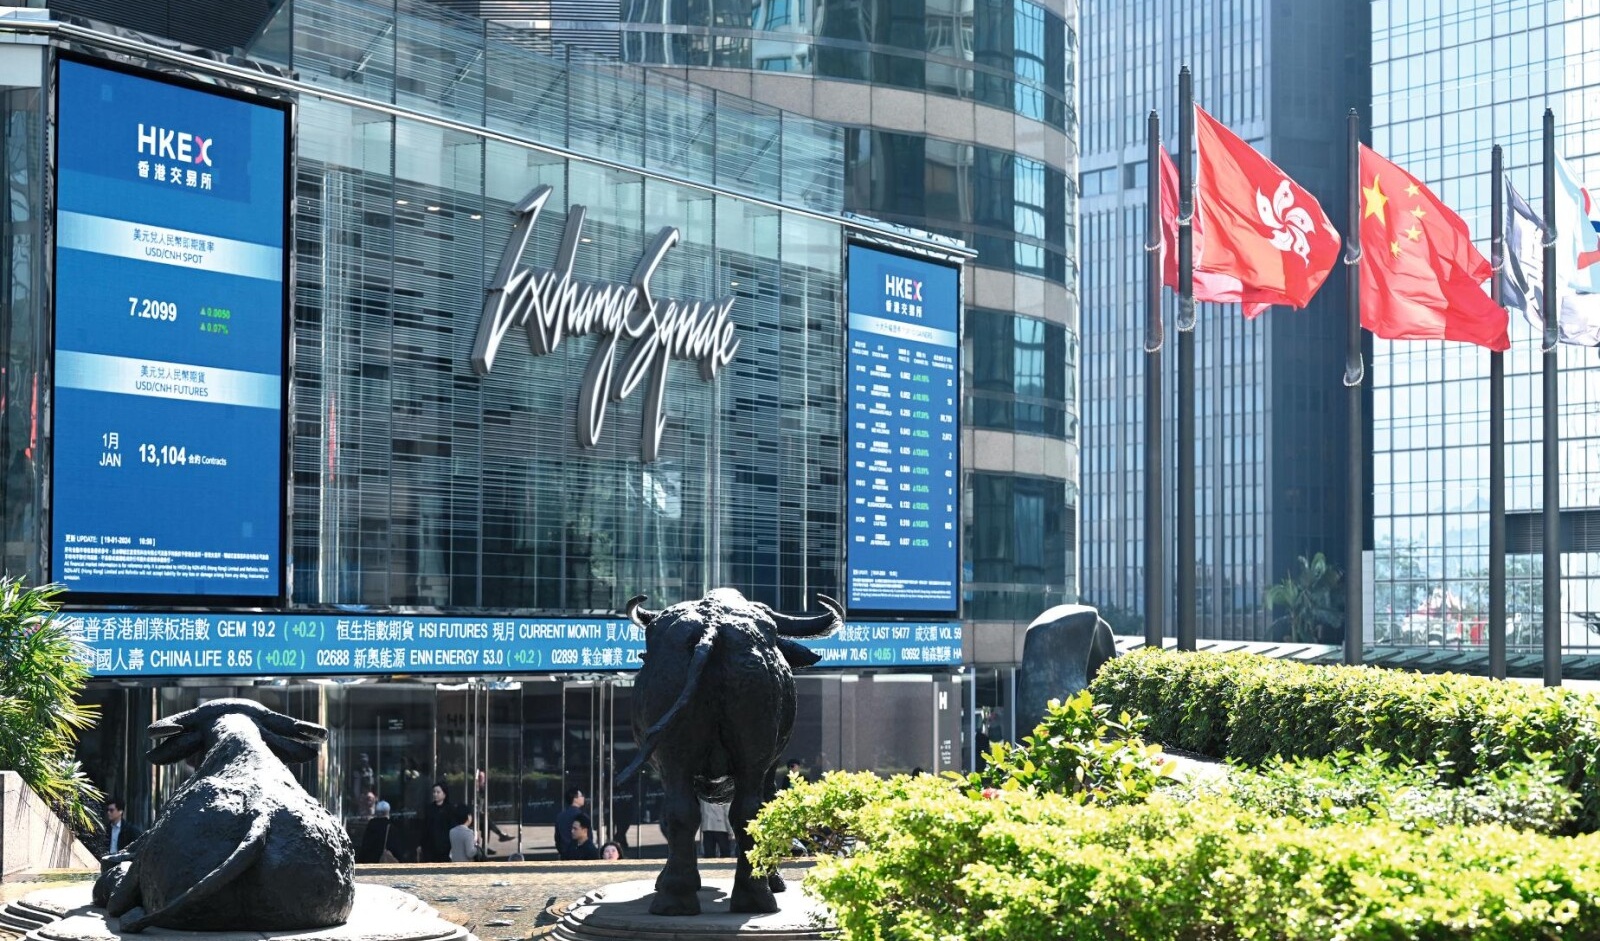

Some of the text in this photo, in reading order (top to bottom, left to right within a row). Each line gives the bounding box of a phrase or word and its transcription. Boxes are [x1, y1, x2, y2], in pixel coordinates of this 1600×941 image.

[137, 123, 213, 167] HKEX
[137, 160, 213, 190] 香港交易所
[145, 246, 204, 264] USD/CNH SPOT
[885, 274, 922, 302] HKEX
[128, 297, 178, 322] 7.2099
[471, 184, 741, 464] Exchange Square
[136, 380, 209, 397] USD/CNH FUTURES
[102, 432, 120, 450] 1月
[99, 452, 122, 468] JAN
[138, 443, 187, 467] 13,104
[201, 456, 228, 467] Contracts
[217, 620, 247, 638] GEM
[252, 620, 275, 638] 19.2
[419, 622, 437, 639] HSI
[439, 622, 488, 639] FUTURES
[492, 621, 515, 642] 現月
[519, 622, 565, 640] CURRENT
[567, 622, 601, 640] MONTH
[872, 626, 889, 640] LAST
[150, 649, 192, 668] CHINA
[194, 649, 222, 667] LIFE
[227, 649, 252, 667] 8.65
[316, 649, 349, 667] 02688
[353, 647, 406, 669] 新奧能源
[410, 649, 433, 666] ENN
[435, 649, 479, 666] ENERGY
[482, 649, 503, 665] 53.0
[551, 648, 578, 665] 02899
[939, 691, 948, 710] H
